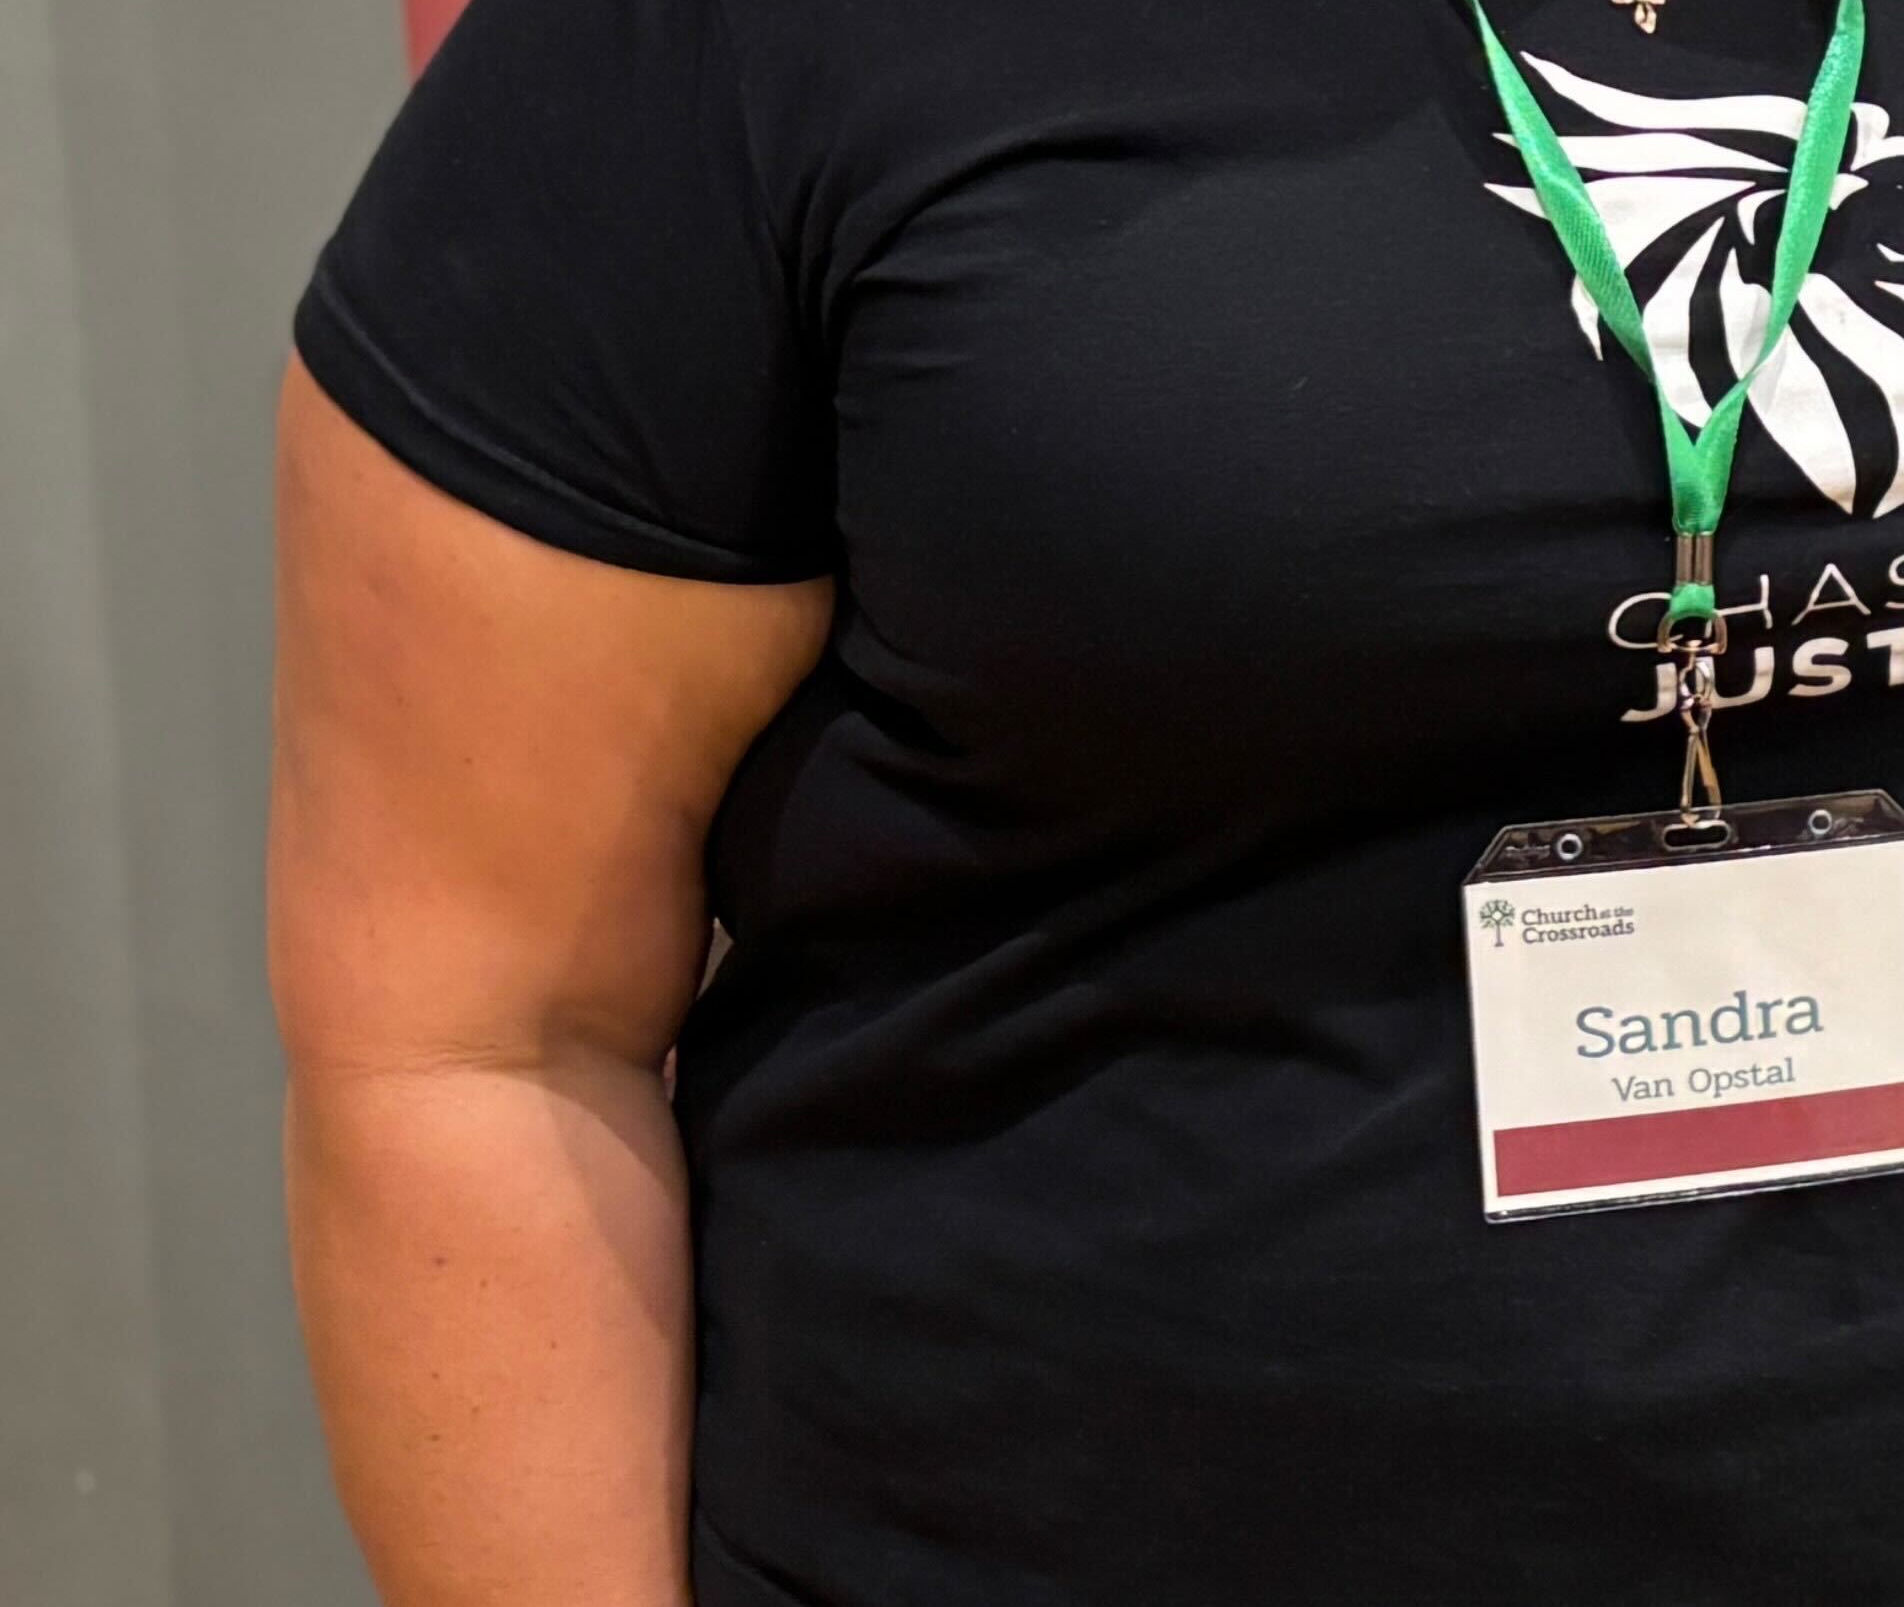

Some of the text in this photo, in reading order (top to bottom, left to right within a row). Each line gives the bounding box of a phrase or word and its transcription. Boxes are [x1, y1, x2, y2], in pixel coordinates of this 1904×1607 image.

[1520, 903, 1599, 927] Church
[1613, 905, 1635, 918] the
[1521, 919, 1636, 945] Crossroads
[1574, 989, 1825, 1060] Sandra
[1611, 1057, 1797, 1104] Van Opstal
